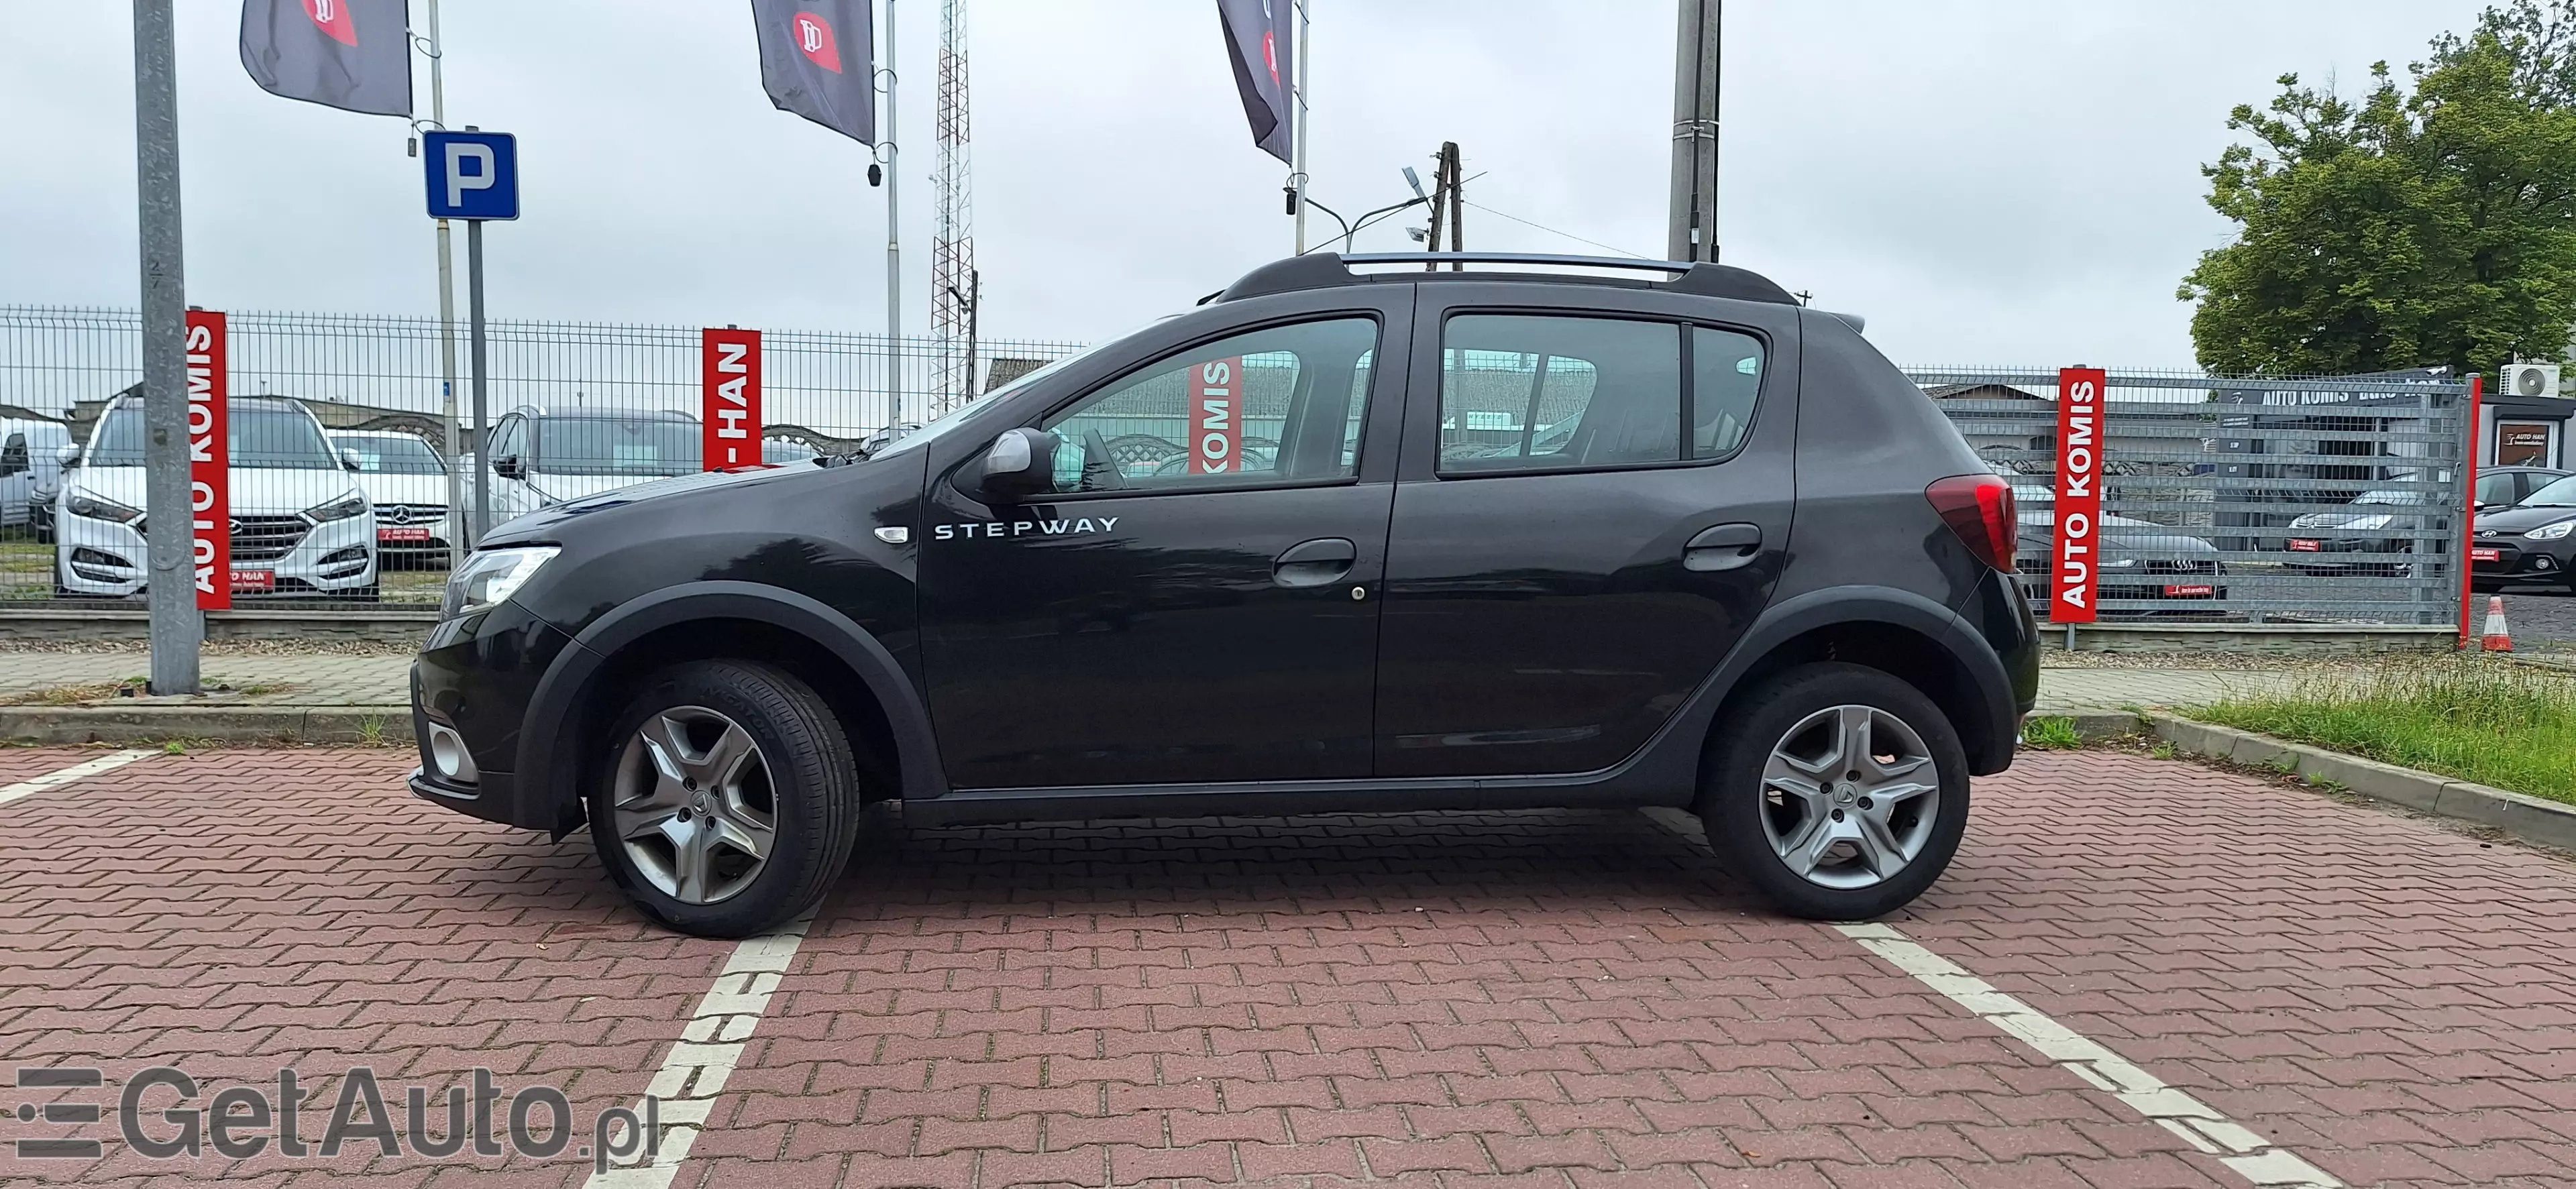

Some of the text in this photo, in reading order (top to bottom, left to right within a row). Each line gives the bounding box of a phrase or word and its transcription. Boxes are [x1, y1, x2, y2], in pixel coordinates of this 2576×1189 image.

[445, 142, 495, 207] P
[186, 325, 215, 595] AUTO KOMIS
[934, 517, 1120, 540] STEPWAY
[2062, 380, 2095, 608] AUTO KOMIS
